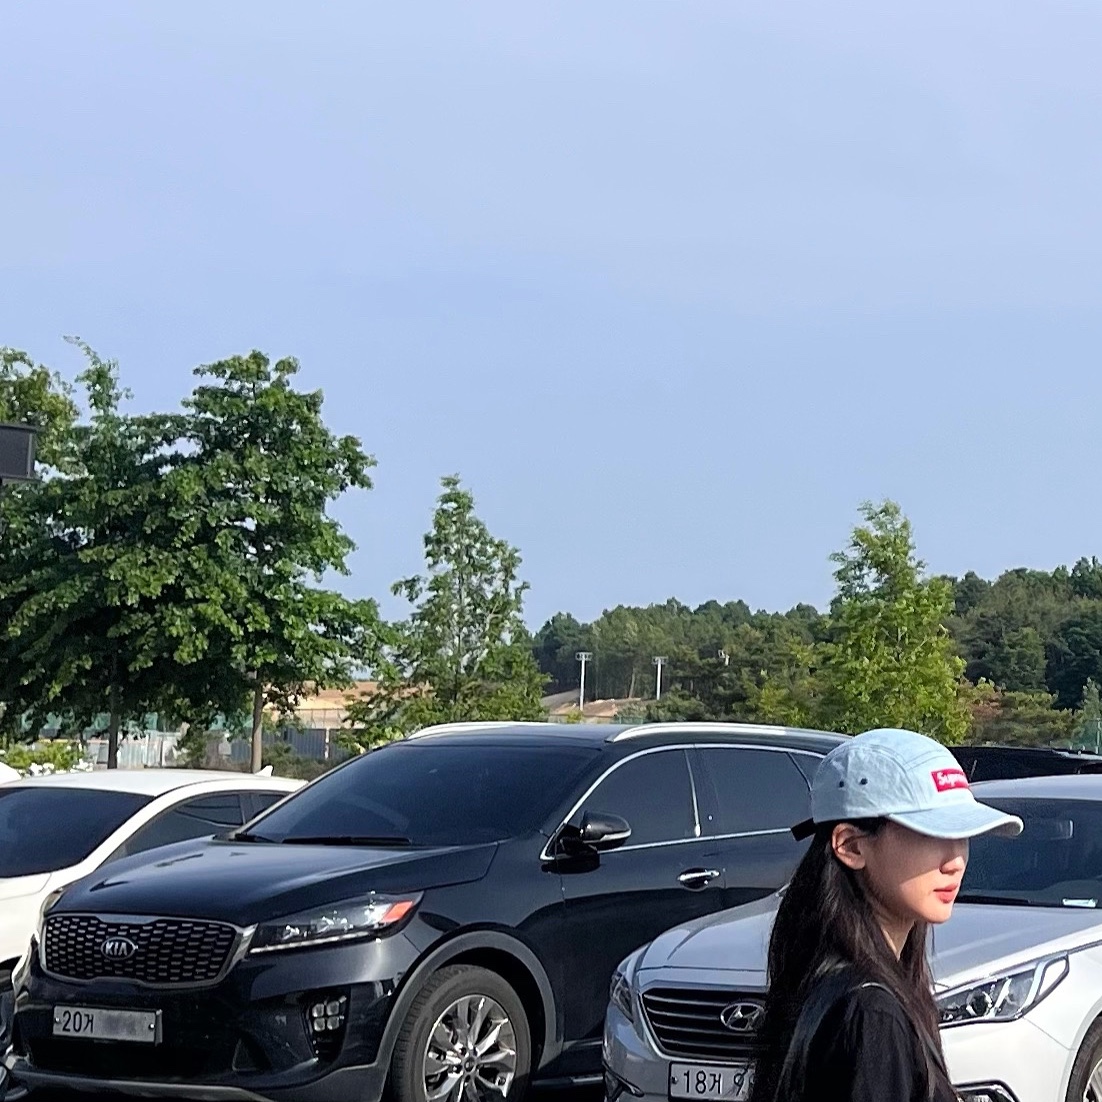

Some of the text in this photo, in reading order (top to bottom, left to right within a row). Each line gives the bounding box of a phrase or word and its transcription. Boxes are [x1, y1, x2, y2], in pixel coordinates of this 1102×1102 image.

[105, 941, 128, 956] KIA
[62, 1010, 94, 1034] 20거
[683, 1070, 722, 1094] 18거
